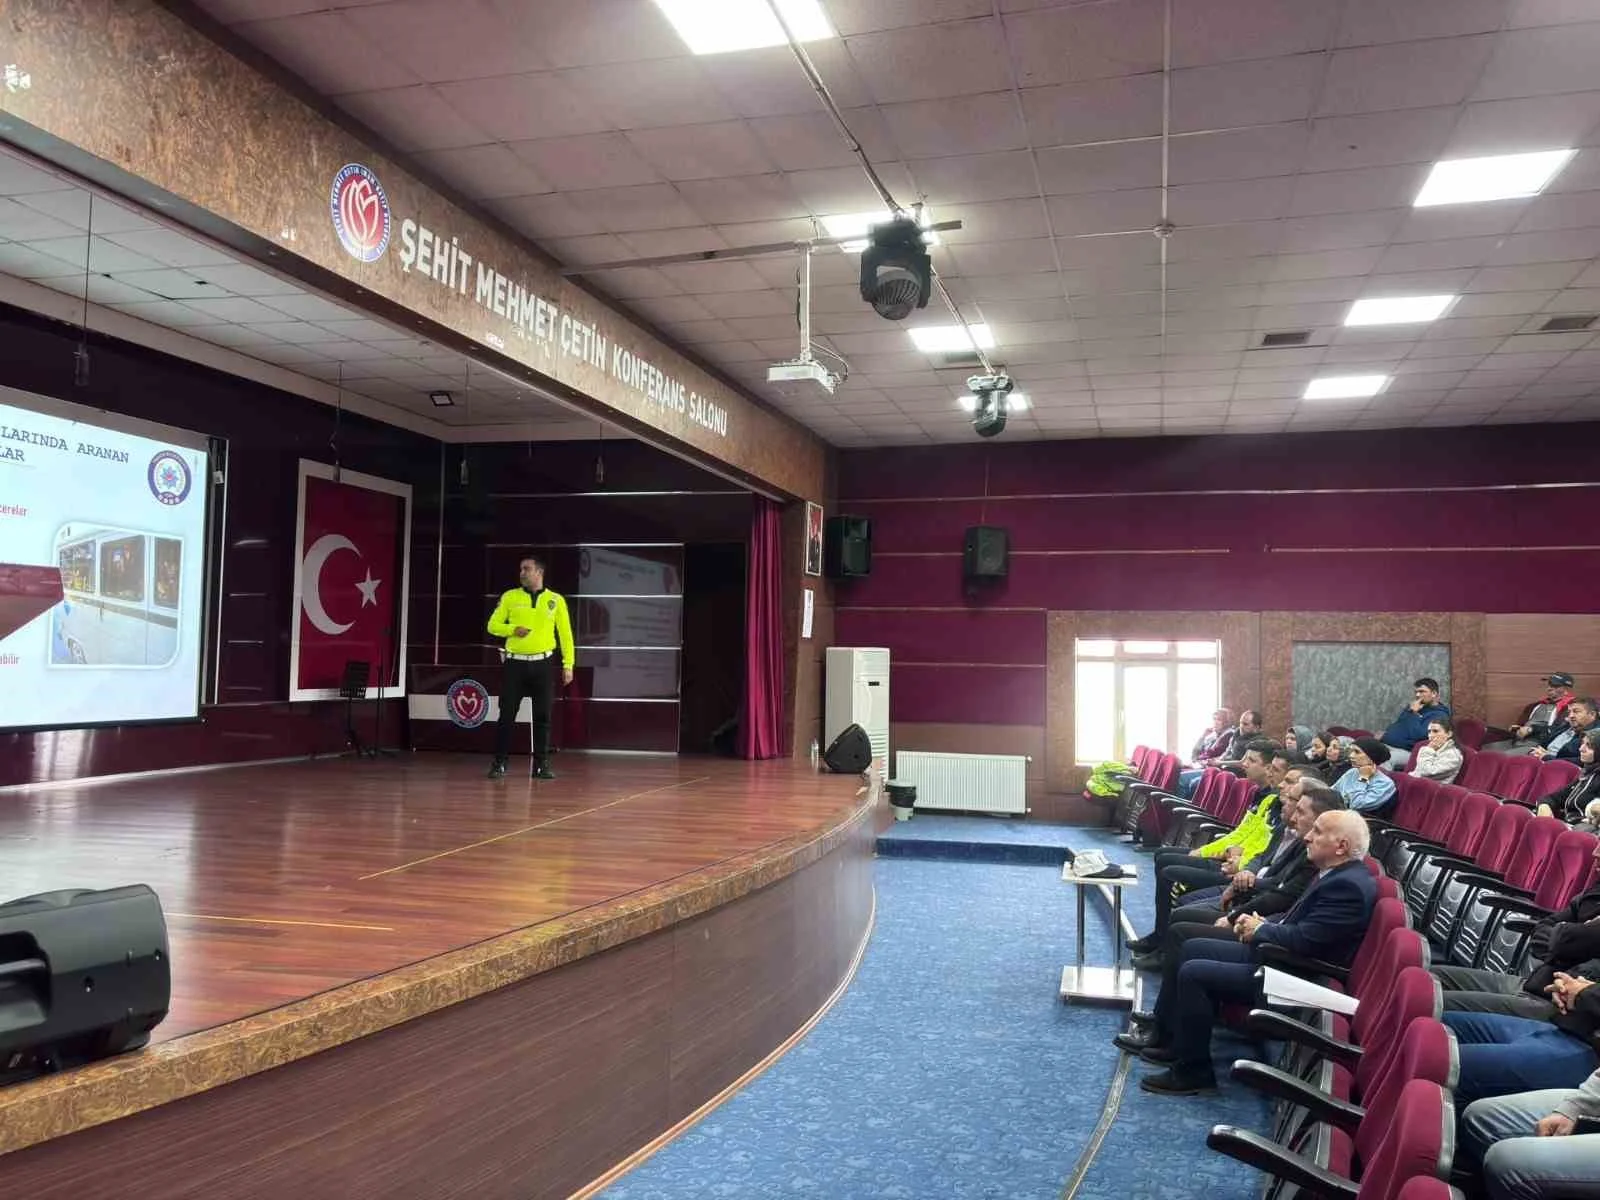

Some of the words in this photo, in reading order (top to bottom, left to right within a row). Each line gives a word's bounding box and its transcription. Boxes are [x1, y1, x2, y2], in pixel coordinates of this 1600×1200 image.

[399, 218, 472, 295] ŞEHİT
[475, 261, 558, 342] MEHMET
[560, 314, 607, 371] ÇETİN
[612, 343, 686, 413] KONFERANS
[688, 391, 728, 437] SALONU
[1, 425, 69, 451] LARINDA
[77, 442, 130, 464] ARANAN
